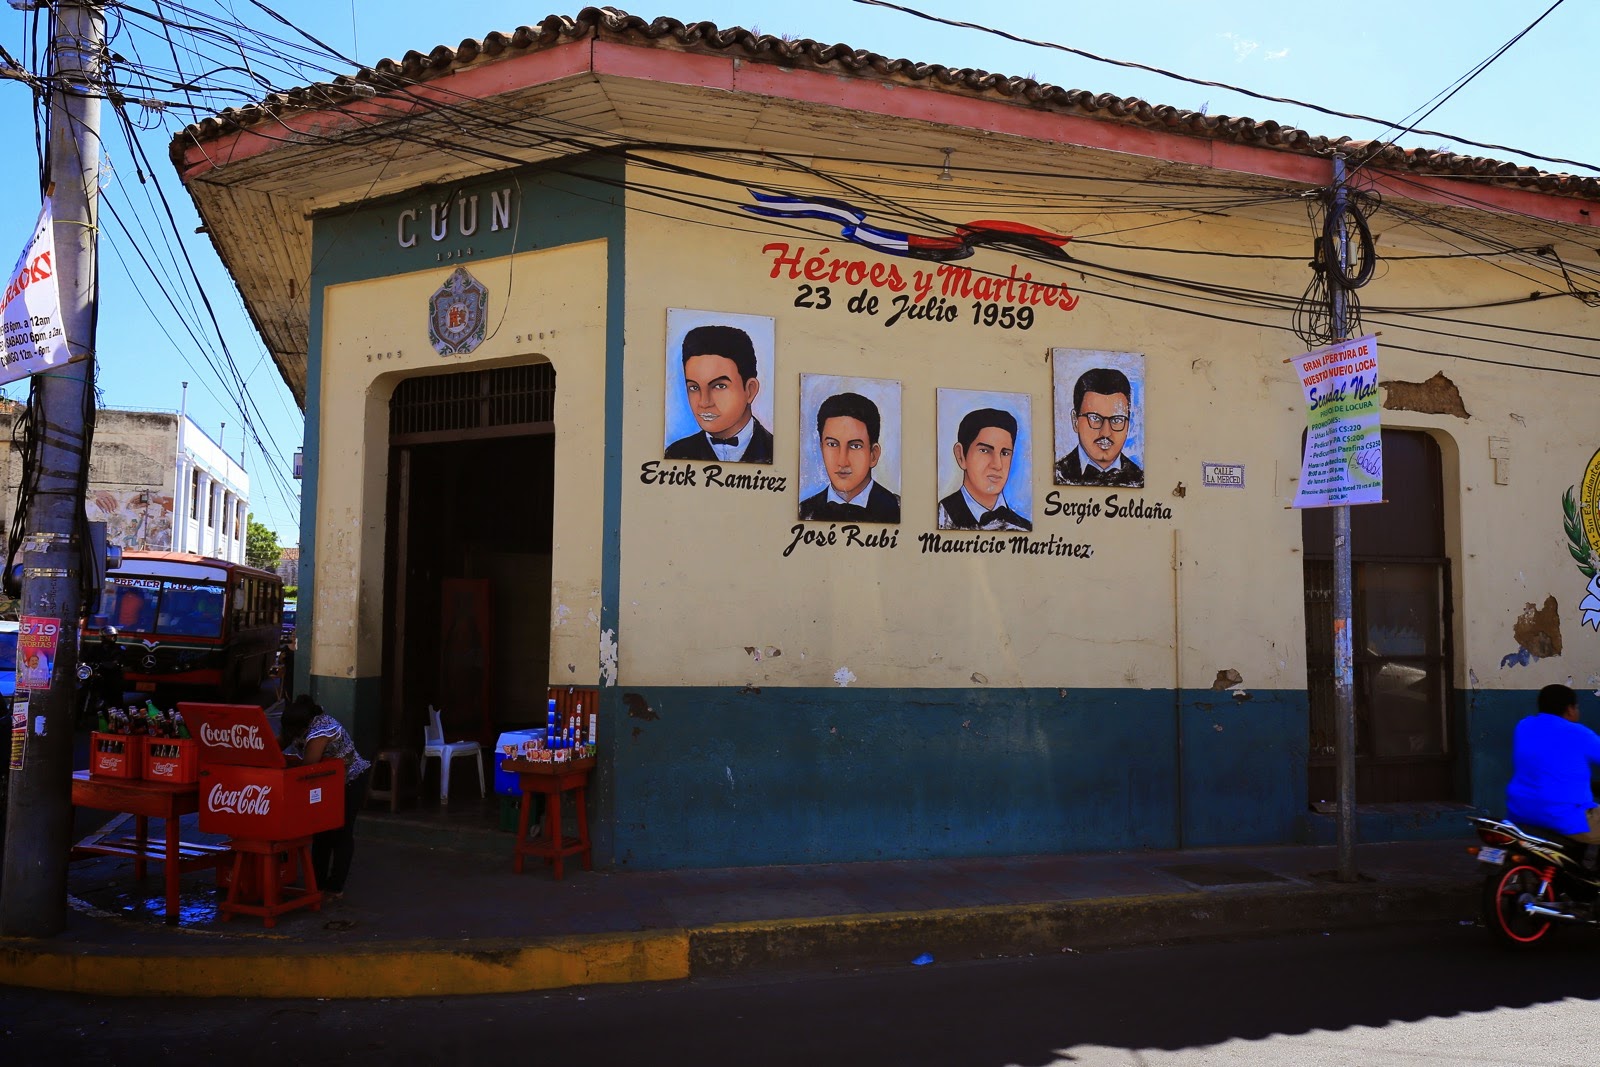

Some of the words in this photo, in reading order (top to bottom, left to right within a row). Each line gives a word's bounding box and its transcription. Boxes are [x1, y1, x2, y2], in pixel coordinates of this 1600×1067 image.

[437, 247, 473, 262] 1914
[762, 242, 908, 293] Héroes
[913, 269, 935, 304] y
[794, 284, 833, 310] 23
[847, 289, 880, 316] de
[884, 294, 959, 328] Julio
[972, 301, 1035, 331] 1959
[30, 316, 50, 327] 12am
[1303, 358, 1322, 373] GRAN
[1357, 345, 1369, 357] DE
[1329, 363, 1353, 379] NUEVO
[1355, 358, 1377, 373] LOCAL
[1335, 404, 1344, 413] DE
[1345, 400, 1373, 412] LOCURA
[640, 460, 697, 487] Erick
[702, 464, 787, 493] Ramirez
[1207, 475, 1215, 483] LA
[1217, 475, 1241, 484] MERCED
[1214, 467, 1233, 475] CALLE
[1044, 490, 1101, 524] Sergio
[1104, 494, 1173, 520] Saldaña
[1587, 516, 1595, 534] Sin
[783, 523, 837, 558] José
[918, 532, 1006, 554] Mauricio
[200, 722, 265, 750] Coca-Cola
[208, 783, 272, 815] Coca-Cola
